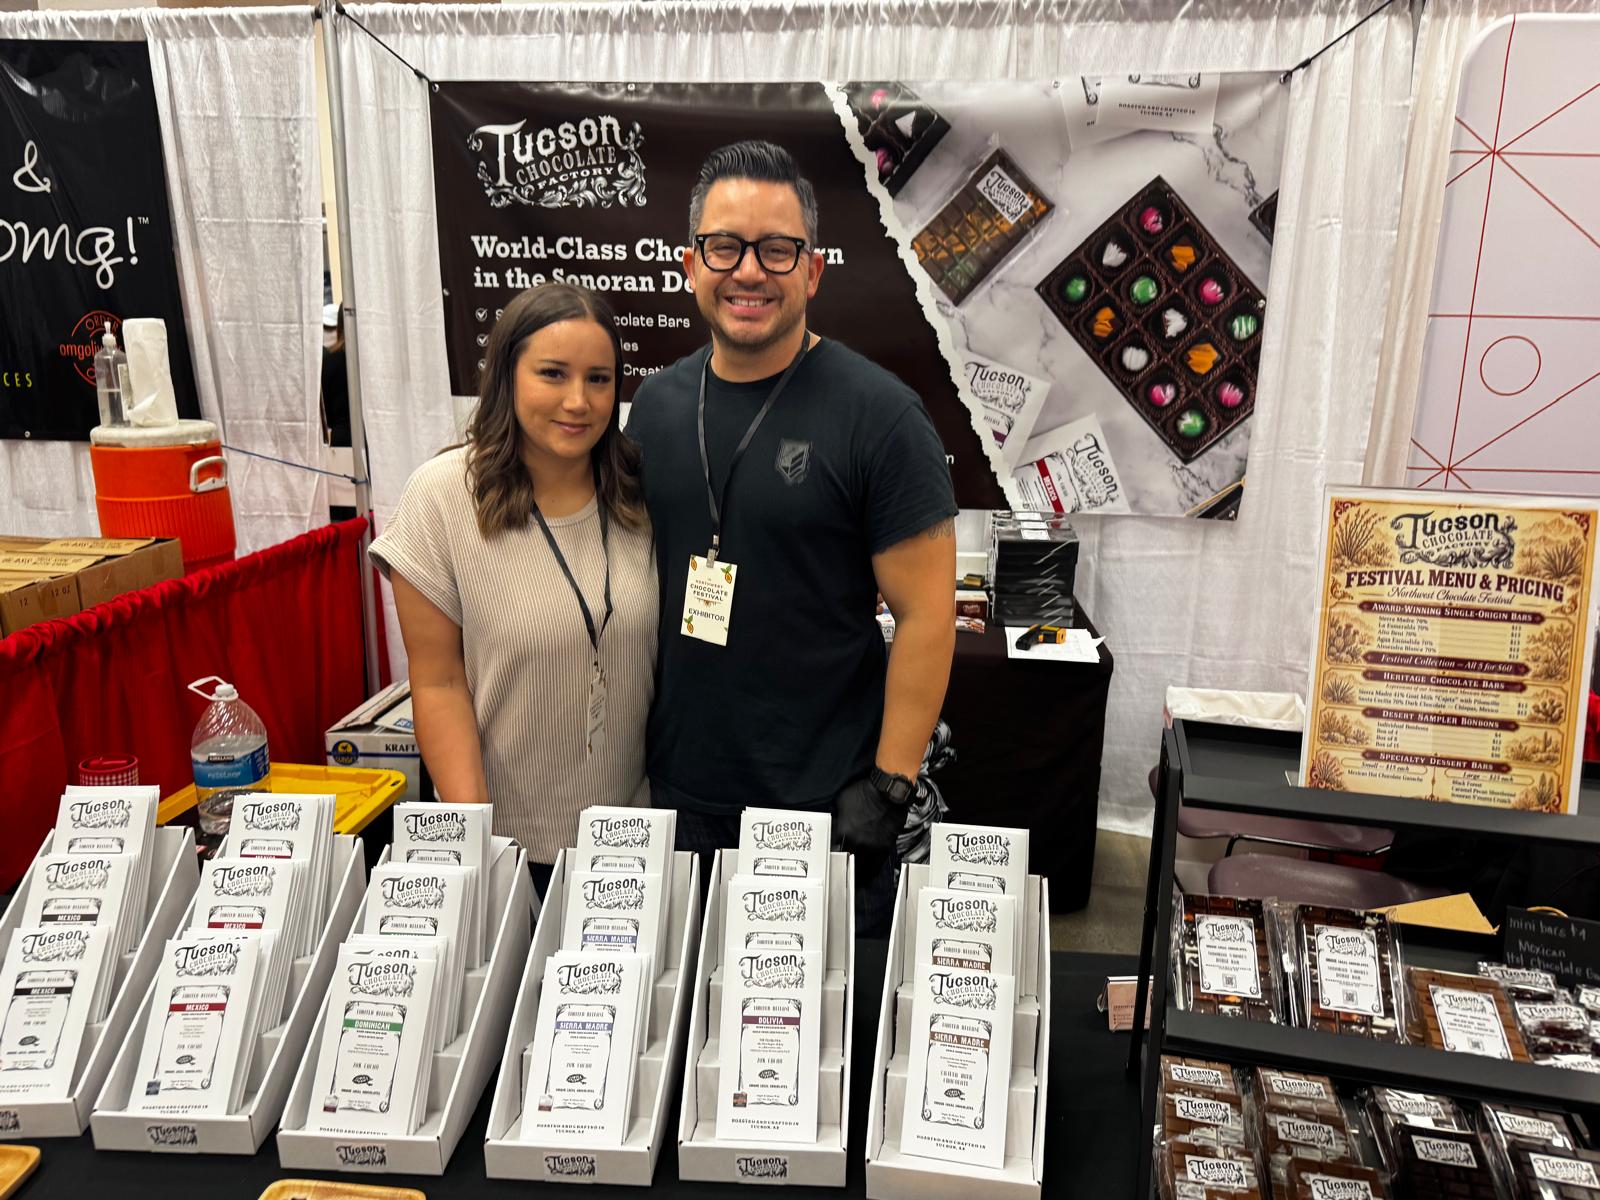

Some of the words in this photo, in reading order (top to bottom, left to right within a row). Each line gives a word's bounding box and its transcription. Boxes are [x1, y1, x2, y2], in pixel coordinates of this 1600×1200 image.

[474, 115, 622, 187] Tucson
[13, 139, 51, 193] &
[515, 145, 618, 185] CHOCOLATE
[537, 166, 614, 191] FACTORY
[986, 171, 1026, 206] Tucson
[471, 234, 627, 261] World-Class
[474, 266, 500, 288] in
[505, 267, 546, 288] the
[657, 314, 690, 328] Bars
[965, 361, 1025, 391] Tucson
[1074, 433, 1118, 493] Tucson
[1391, 510, 1500, 550] Tucson
[1422, 530, 1493, 550] CHOCOLATE
[1437, 542, 1490, 552] FACTORY
[690, 584, 728, 596] CHOCOLATE
[693, 590, 723, 602] FESTIVAL
[1345, 570, 1425, 588] FESTIVAL
[1428, 569, 1476, 589] MENU
[1479, 574, 1492, 590] &
[1496, 574, 1564, 603] PRICING
[1388, 586, 1434, 600] Northwest
[1436, 588, 1476, 602] Chocolate
[1478, 592, 1516, 605] Festival
[688, 608, 725, 622] EXHIBITOR
[1511, 612, 1532, 622] BARS
[1381, 654, 1413, 664] Festival
[1414, 657, 1456, 668] Collection
[1464, 661, 1476, 670] All
[1484, 662, 1496, 672] for
[1497, 664, 1513, 672] $60
[1384, 672, 1426, 684] HERITAGE
[1430, 674, 1478, 688] CHOCOLATE
[1482, 680, 1505, 690] BARS
[385, 743, 416, 752] KRAFT
[1380, 752, 1426, 764] SPECIALTY
[1430, 758, 1468, 768] DESSERT
[1471, 762, 1494, 770] BARS
[70, 799, 125, 822] Tucson
[243, 802, 295, 824] Tucson
[404, 812, 459, 834] Tucson
[590, 818, 644, 840] Tucson
[752, 820, 806, 842] Tucson
[946, 832, 1002, 854] Tucson
[46, 860, 104, 884] Tucson
[212, 866, 269, 888] Tucson
[381, 876, 438, 900] Tucson
[582, 878, 638, 901] Tucson
[742, 890, 800, 914] Tucson
[930, 898, 989, 921] Tucson
[224, 922, 246, 930] MEXICO
[1206, 923, 1240, 936] Tucson
[1510, 917, 1536, 932] mini
[1540, 920, 1566, 938] bars
[22, 930, 83, 953] Tucson
[1325, 934, 1361, 949] Tucson
[1518, 939, 1566, 958] Mexican
[175, 942, 234, 969] Tucson
[936, 957, 960, 968] SIERRA
[962, 959, 986, 970] MADRE
[348, 961, 410, 986] Tucson
[558, 962, 616, 985] Tucson
[739, 954, 798, 980] Tucson
[30, 987, 56, 995] MEXICO
[929, 972, 990, 996] Tucson
[186, 1004, 210, 1012] MEXICO
[354, 1020, 391, 1030] DOMINICAN
[559, 1022, 583, 1030] SIERRA
[586, 1022, 609, 1031] MADRE
[758, 1016, 784, 1025] BOLIVIA
[934, 1033, 958, 1044] SIERRA
[960, 1036, 985, 1048] MADRE
[1172, 1066, 1215, 1080] Tucson
[1178, 1098, 1222, 1114] Tucson
[1279, 1120, 1326, 1136] Tucson
[1188, 1160, 1236, 1176] Tucson
[1312, 1178, 1362, 1194] Tucson
